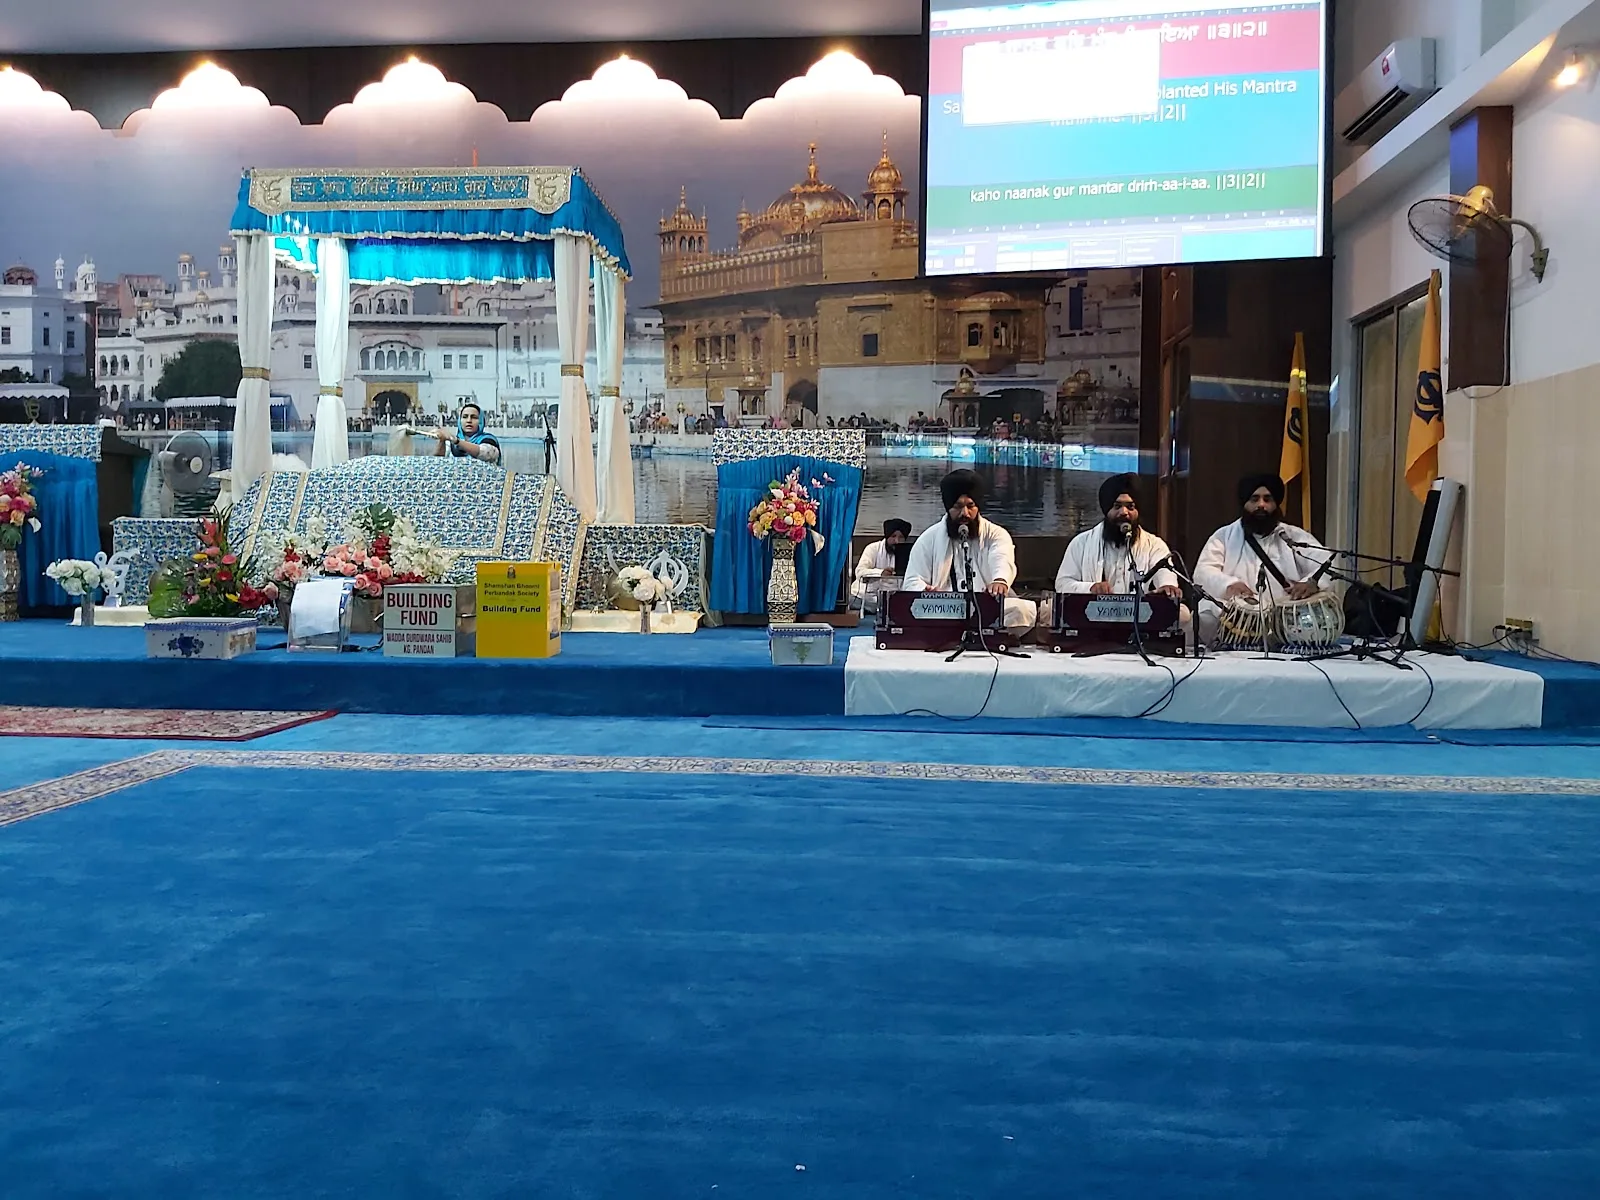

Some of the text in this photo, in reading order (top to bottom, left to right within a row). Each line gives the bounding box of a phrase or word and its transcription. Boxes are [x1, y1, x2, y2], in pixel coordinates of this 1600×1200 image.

[1213, 81, 1238, 97] His
[1242, 78, 1298, 95] Mantra
[970, 188, 1001, 203] kaho
[1004, 184, 1051, 201] naanak
[1053, 184, 1076, 200] gur
[1078, 180, 1125, 196] mantar
[387, 592, 453, 608] BUILDING
[482, 605, 541, 614] Building Fund
[1097, 607, 1136, 617] YAMUN
[400, 610, 438, 626] FUND
[406, 633, 435, 643] GURDWARA
[436, 633, 452, 643] SAHIB
[413, 644, 435, 654] PANDAN
